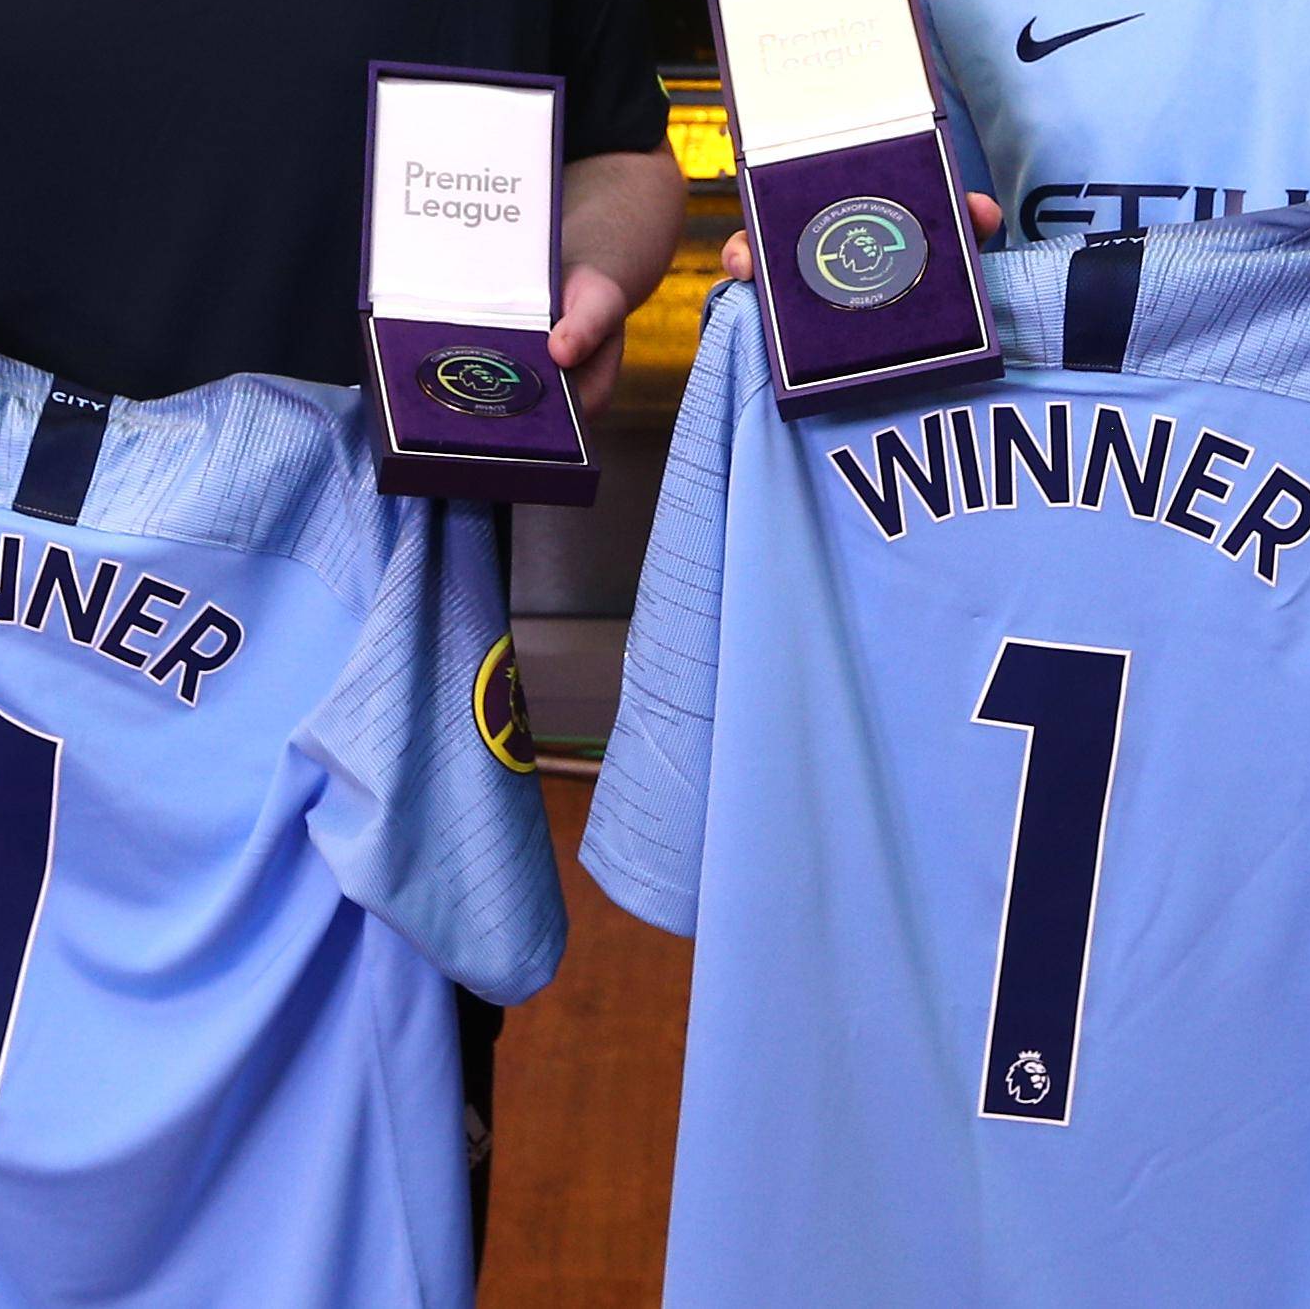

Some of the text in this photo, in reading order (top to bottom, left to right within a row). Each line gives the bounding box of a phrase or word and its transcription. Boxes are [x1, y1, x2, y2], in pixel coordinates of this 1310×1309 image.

[404, 160, 522, 195] Premier
[403, 188, 522, 228] League
[812, 203, 903, 234] CLUB PLAYOFF WINNER
[52, 391, 106, 412] CITY
[970, 635, 1133, 1126] 1
